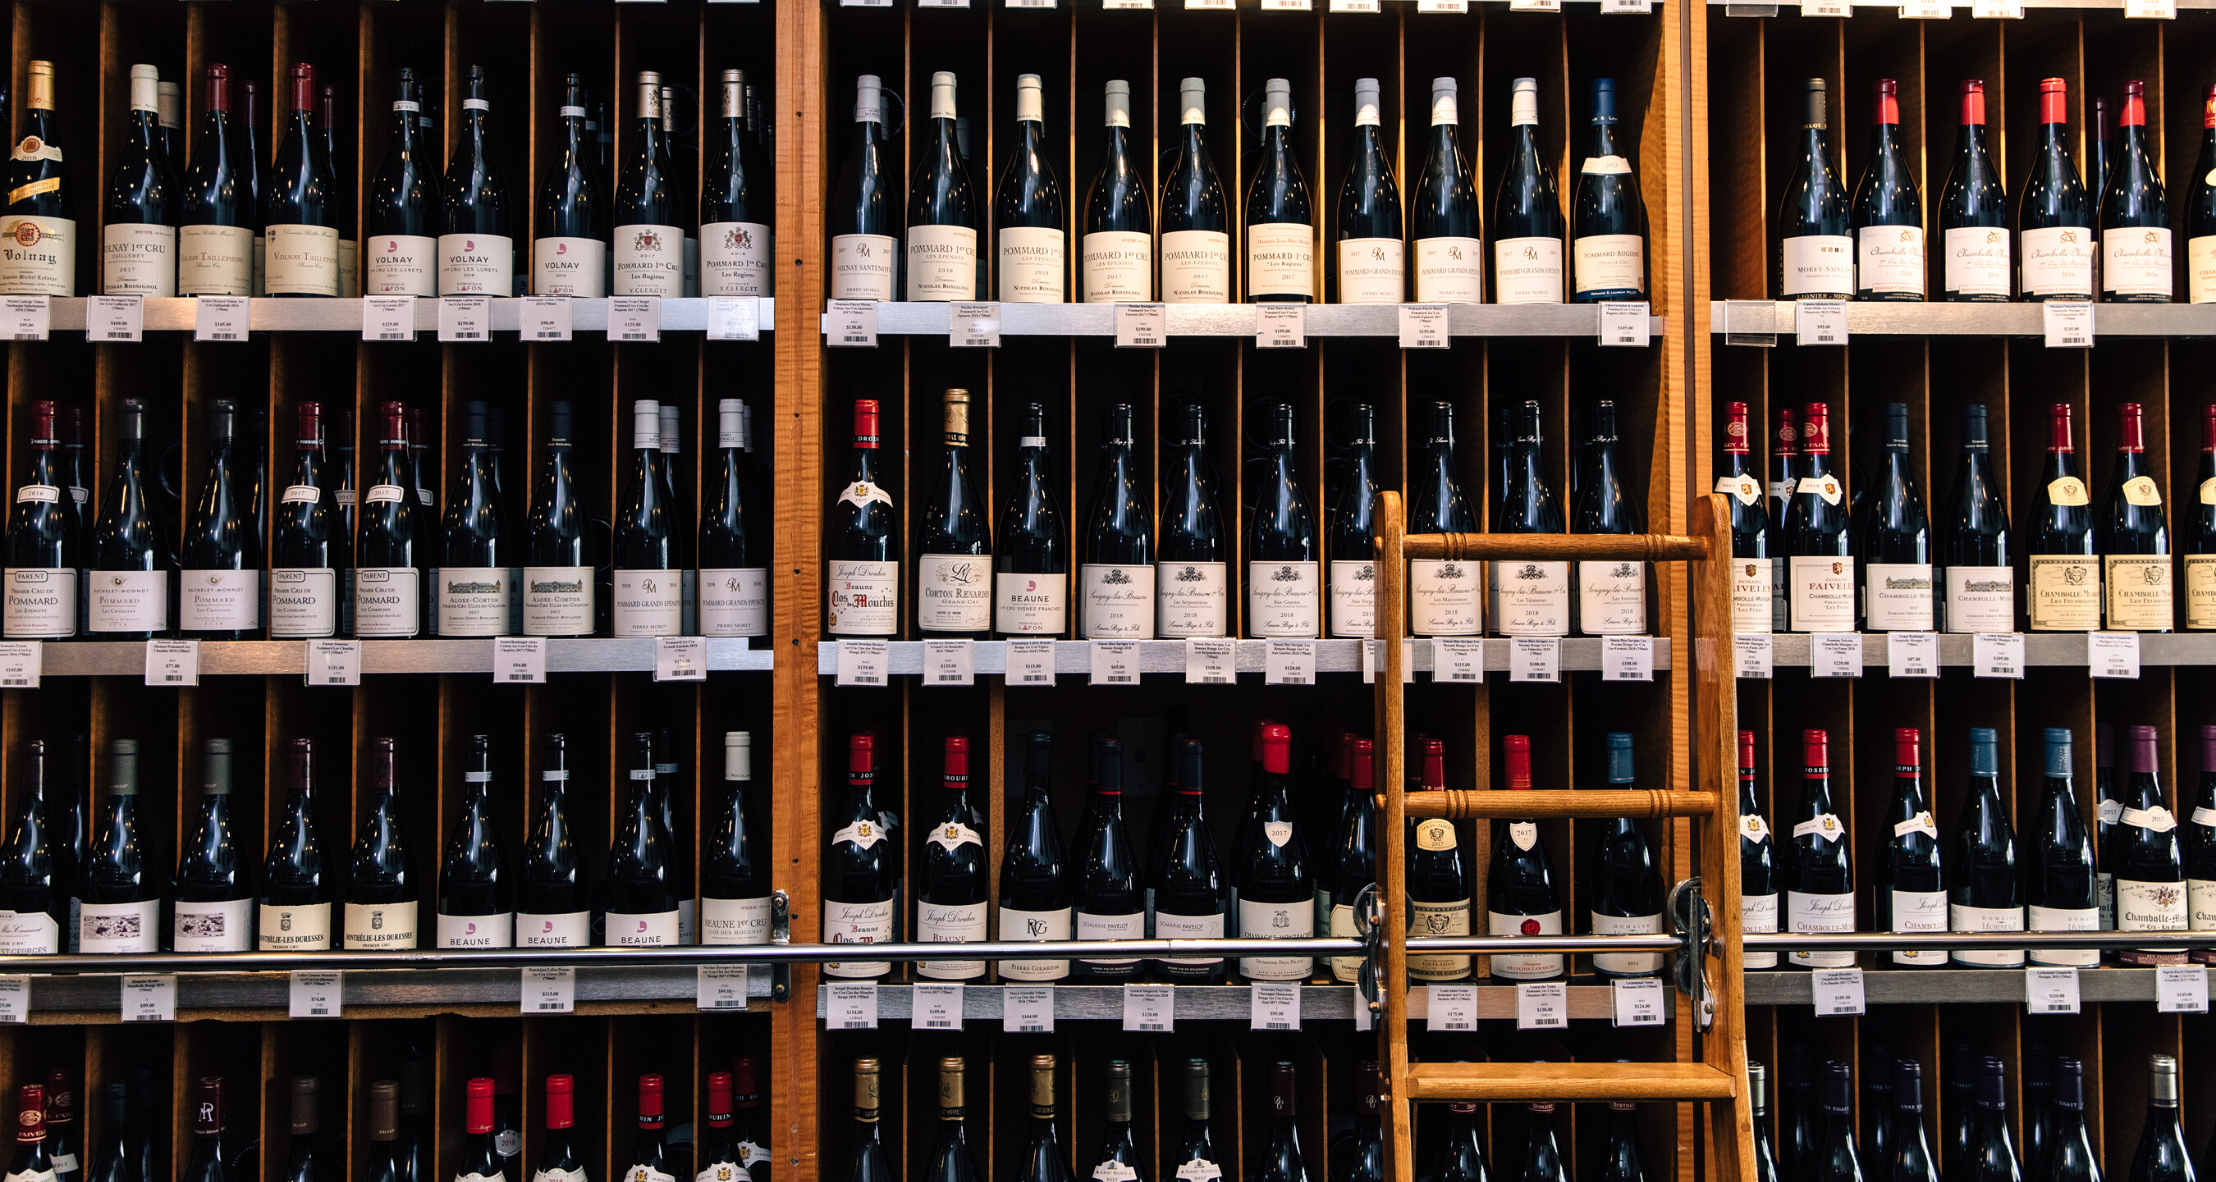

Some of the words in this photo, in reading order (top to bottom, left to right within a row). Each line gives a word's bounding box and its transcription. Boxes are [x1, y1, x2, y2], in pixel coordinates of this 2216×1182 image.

[145, 243, 166, 254] CRU
[909, 243, 954, 255] POMMARD
[1003, 247, 1048, 257] POMMARD
[273, 252, 301, 261] VOLNAY
[1083, 250, 1122, 263] POMMARD
[1164, 250, 1208, 261] POMMARD
[1253, 253, 1293, 262] POMMARD
[1583, 250, 1615, 259] POMMARD
[375, 256, 413, 264] VOLNAY
[449, 255, 490, 264] VOLNAY
[544, 261, 580, 270] VOLNAY
[617, 262, 648, 271] POMMARD
[706, 260, 744, 269] POMMARD
[363, 572, 387, 580] PARENT
[925, 587, 954, 599] CORTON
[8, 595, 59, 606] POMMARD
[99, 596, 140, 605] POMMARD
[194, 595, 236, 604] POMMARD
[357, 595, 400, 605] POMMARD
[641, 600, 664, 608] GRANDS
[725, 599, 748, 607] GRANDS
[1011, 595, 1050, 604] BEAUNE
[704, 918, 737, 928] BEAUNE
[750, 917, 767, 927] CRU
[294, 934, 324, 943] DURESSES
[386, 932, 413, 941] DURESSES
[527, 936, 568, 945] BEAUNE
[621, 935, 662, 944] BEAUNE
[449, 937, 491, 946] BEAUNE
[1011, 964, 1033, 972] PIERRE
